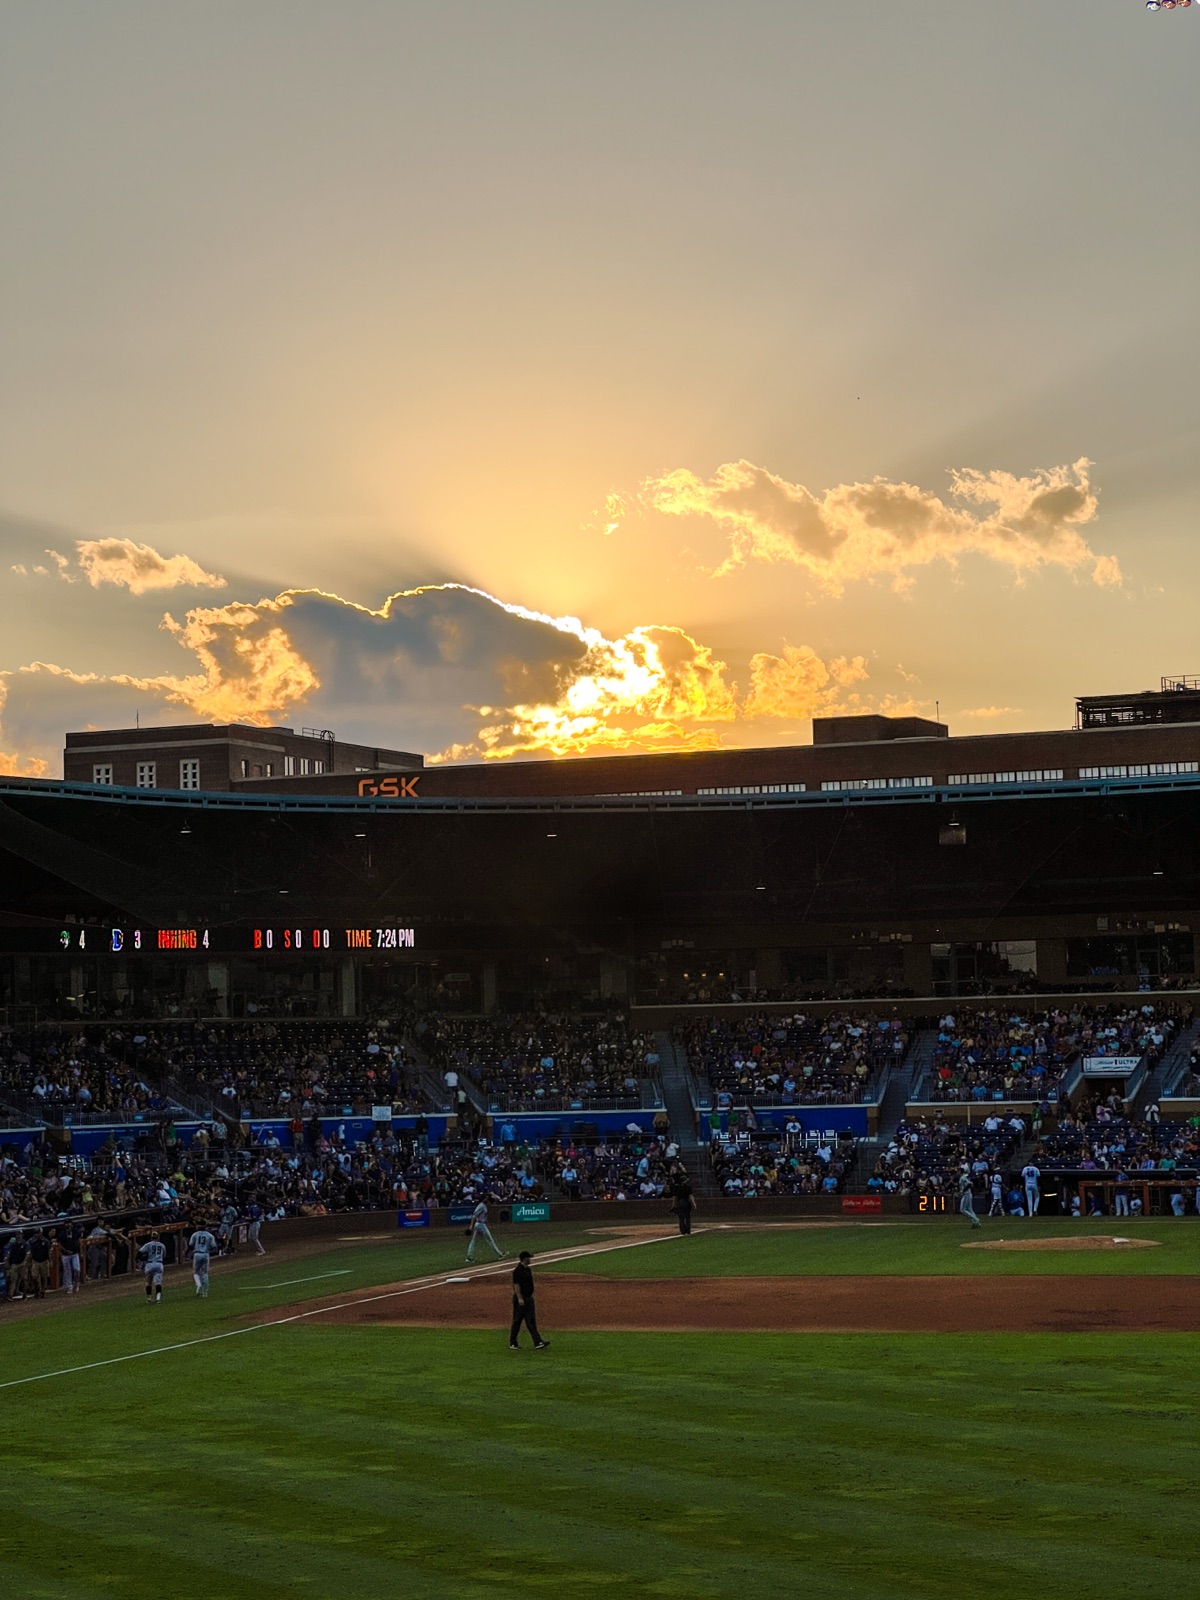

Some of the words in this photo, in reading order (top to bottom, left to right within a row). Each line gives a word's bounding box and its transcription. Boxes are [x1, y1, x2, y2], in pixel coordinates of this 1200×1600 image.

[358, 776, 420, 797] GSK
[79, 930, 86, 949] 4
[134, 930, 141, 949] 3
[202, 930, 209, 949] 4
[253, 929, 262, 948] B
[266, 929, 273, 948] 0
[284, 929, 291, 948] S
[295, 929, 302, 948] 0
[323, 929, 330, 948] 0
[345, 929, 372, 948] TIME
[376, 929, 397, 948] 7:24
[398, 928, 415, 948] PM
[516, 1205, 545, 1216] Amica
[198, 1235, 206, 1245] 13
[151, 1245, 162, 1255] 99
